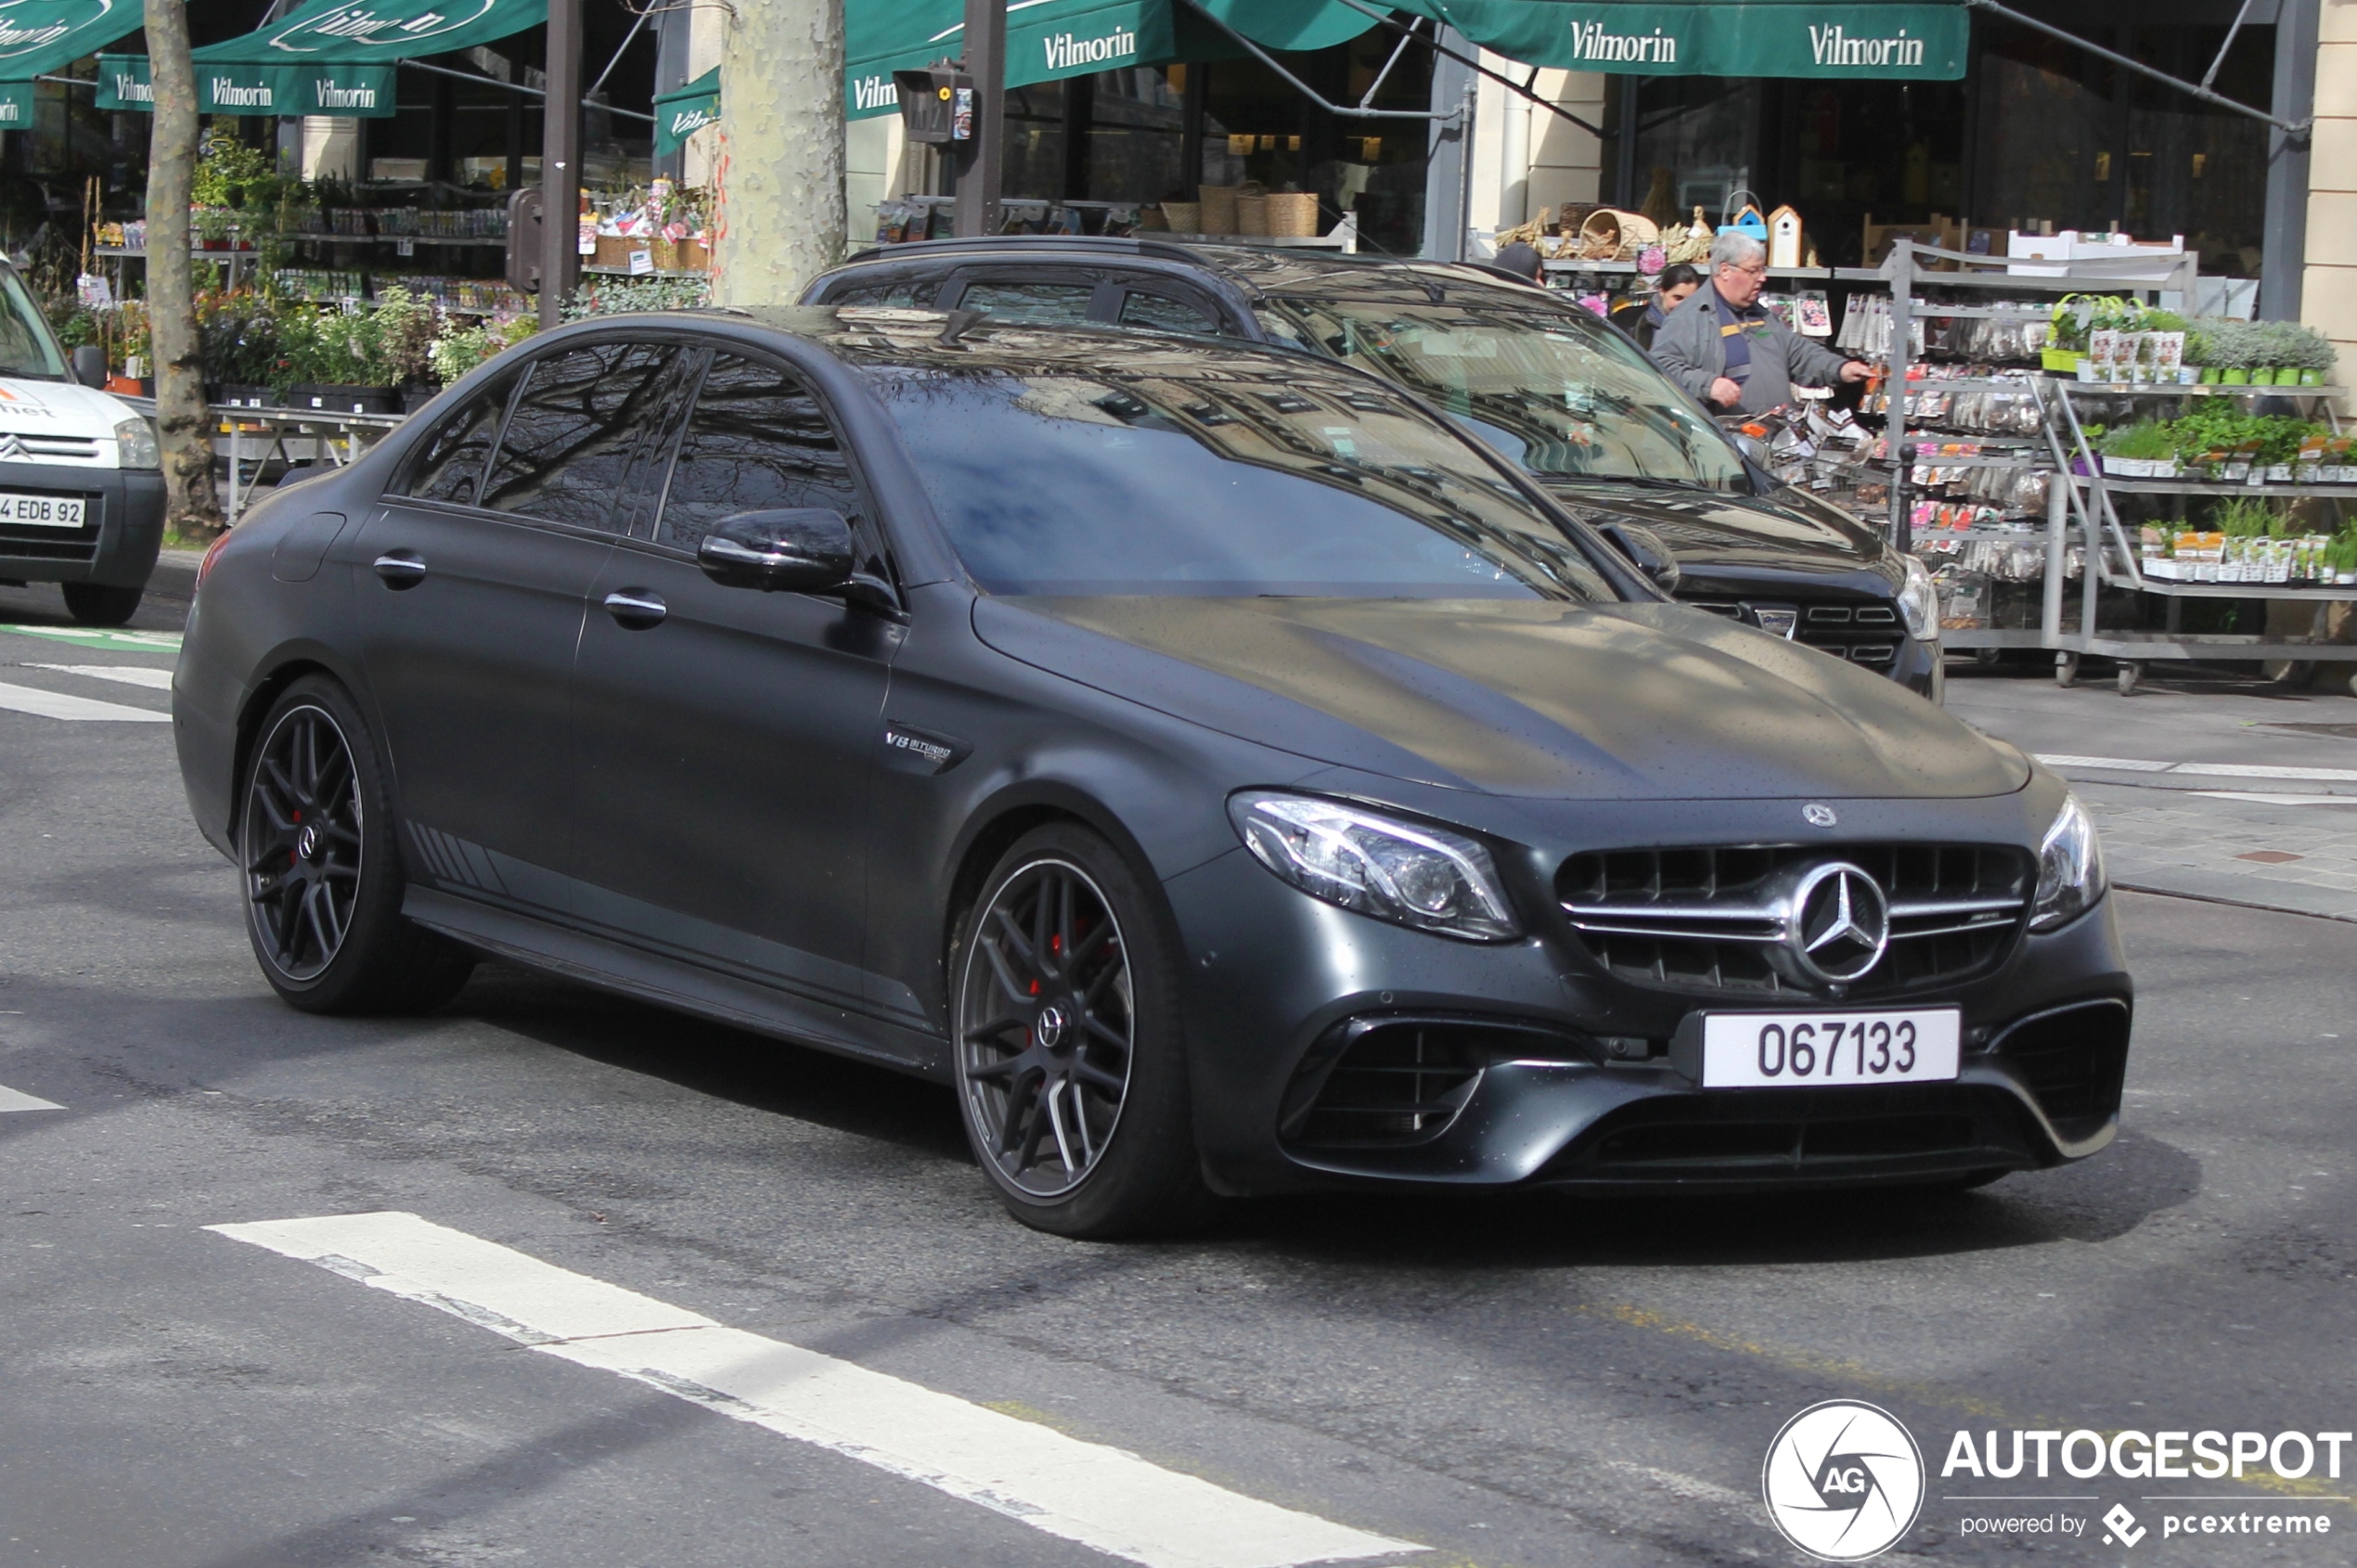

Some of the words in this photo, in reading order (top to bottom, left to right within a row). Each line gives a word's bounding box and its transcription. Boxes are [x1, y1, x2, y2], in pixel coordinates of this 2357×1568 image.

[1043, 25, 1136, 70] Vilmorin
[1570, 19, 1676, 62] Vilmorin
[1808, 22, 1924, 66] Vilmorin
[116, 73, 155, 102] Vilmo
[213, 76, 272, 106] Vilmorin
[316, 78, 375, 108] Vilmorin
[18, 500, 51, 521] EDB
[58, 503, 80, 522] 92
[886, 732, 909, 749] V8
[909, 739, 951, 757] BITURBO
[1758, 1020, 1916, 1077] 067133
